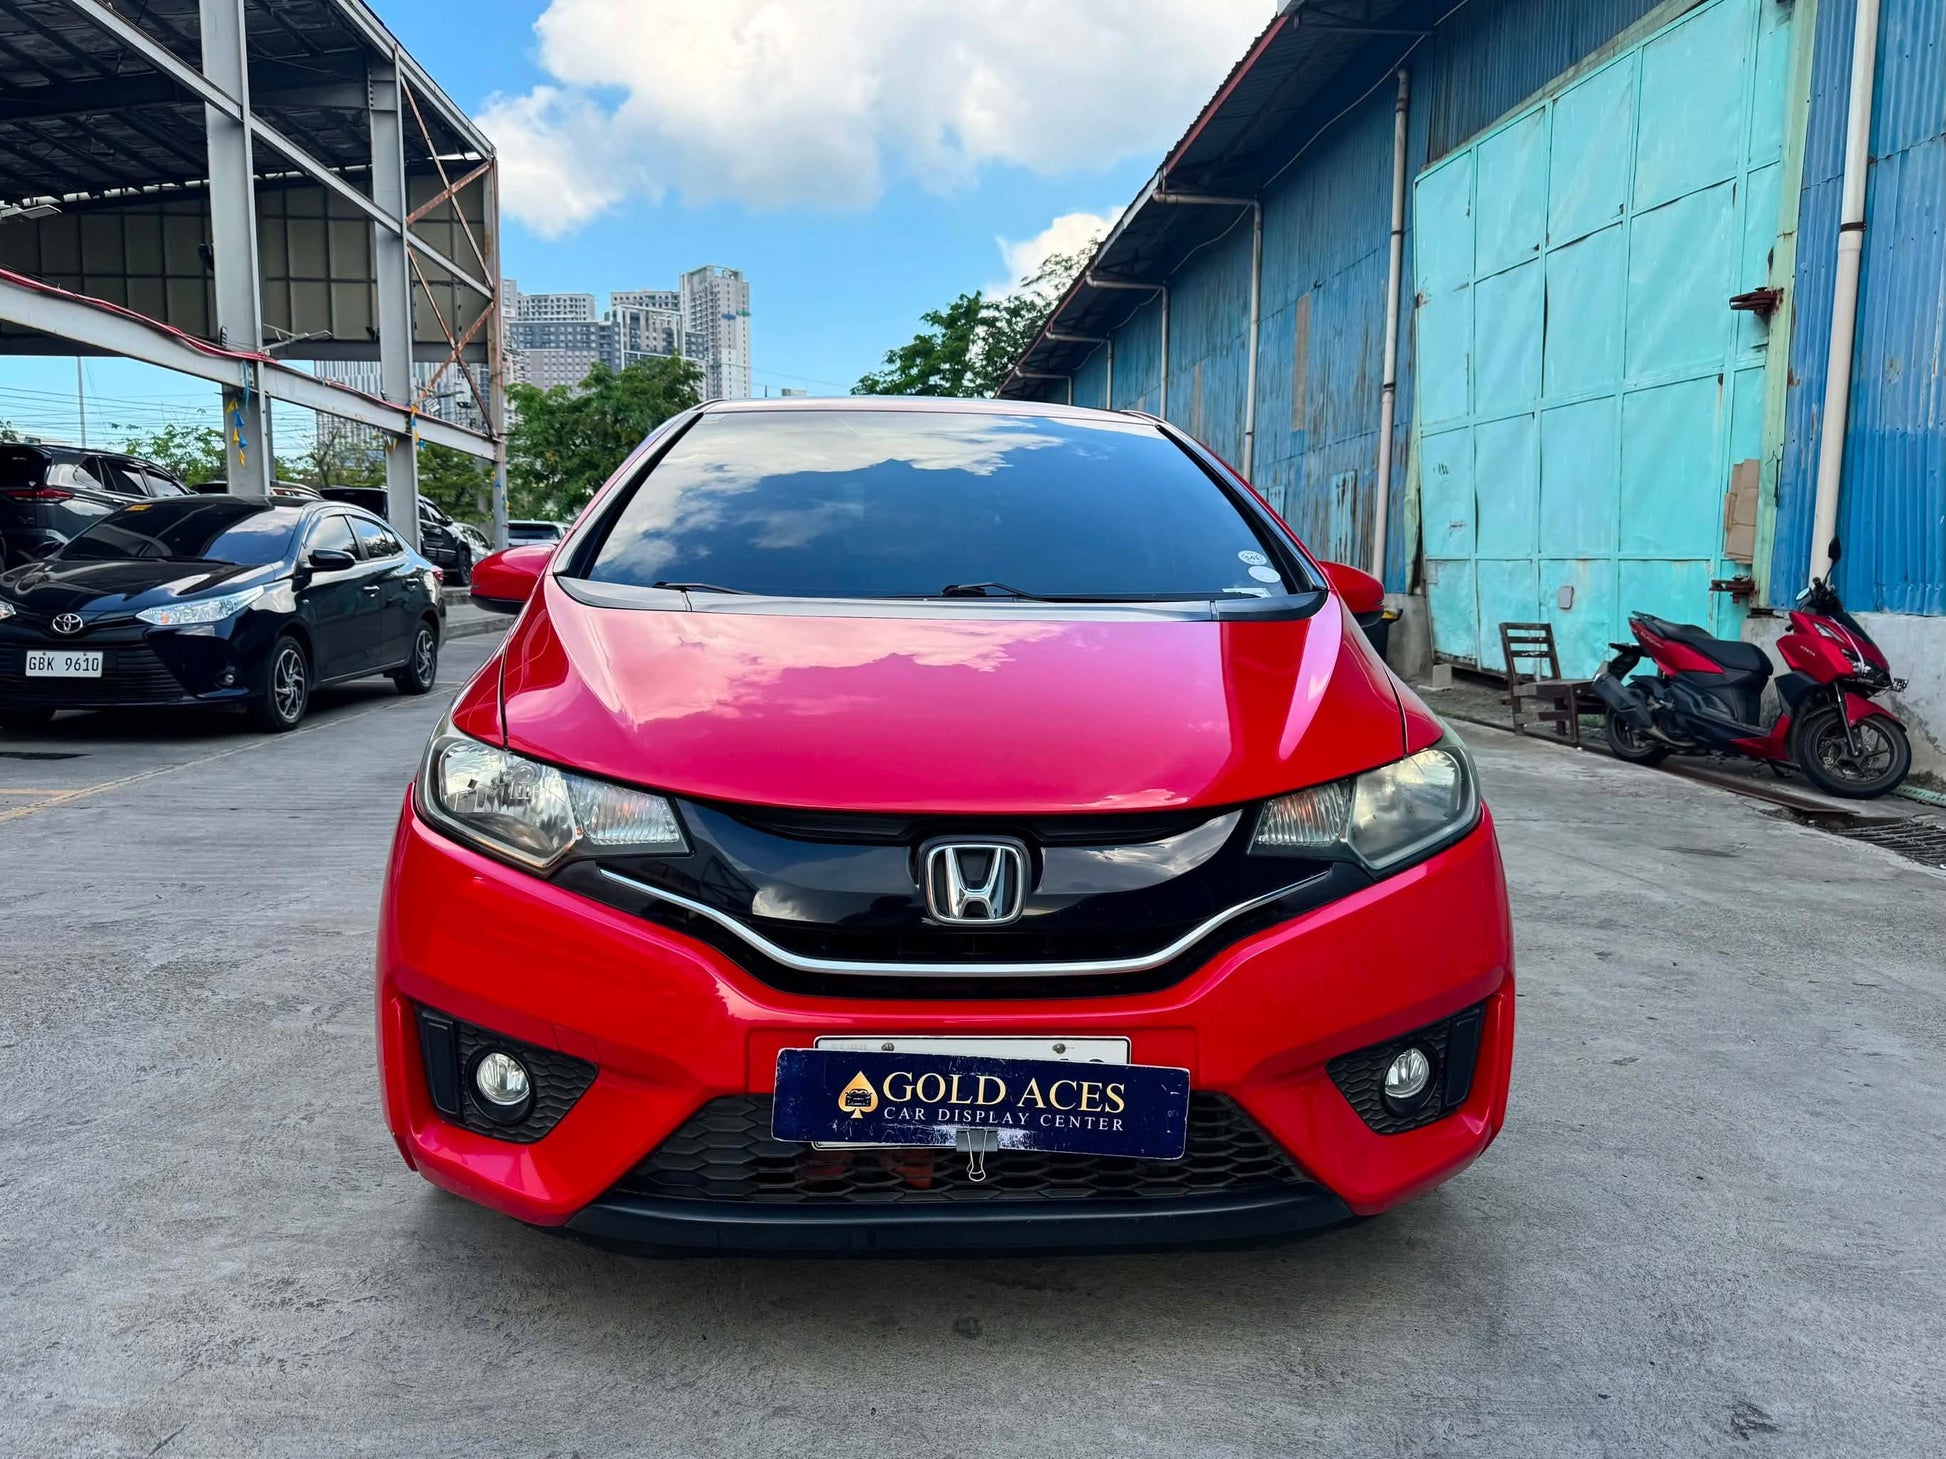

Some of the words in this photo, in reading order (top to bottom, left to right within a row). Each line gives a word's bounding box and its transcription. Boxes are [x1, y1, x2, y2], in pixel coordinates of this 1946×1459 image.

[29, 656, 55, 671] GBK
[65, 657, 99, 672] 9610
[883, 1071, 1007, 1106] GOLD
[1016, 1077, 1125, 1114] ACES
[884, 1106, 926, 1121] CAR
[937, 1108, 1030, 1125] DISPLAY
[1040, 1114, 1124, 1132] CENTER
